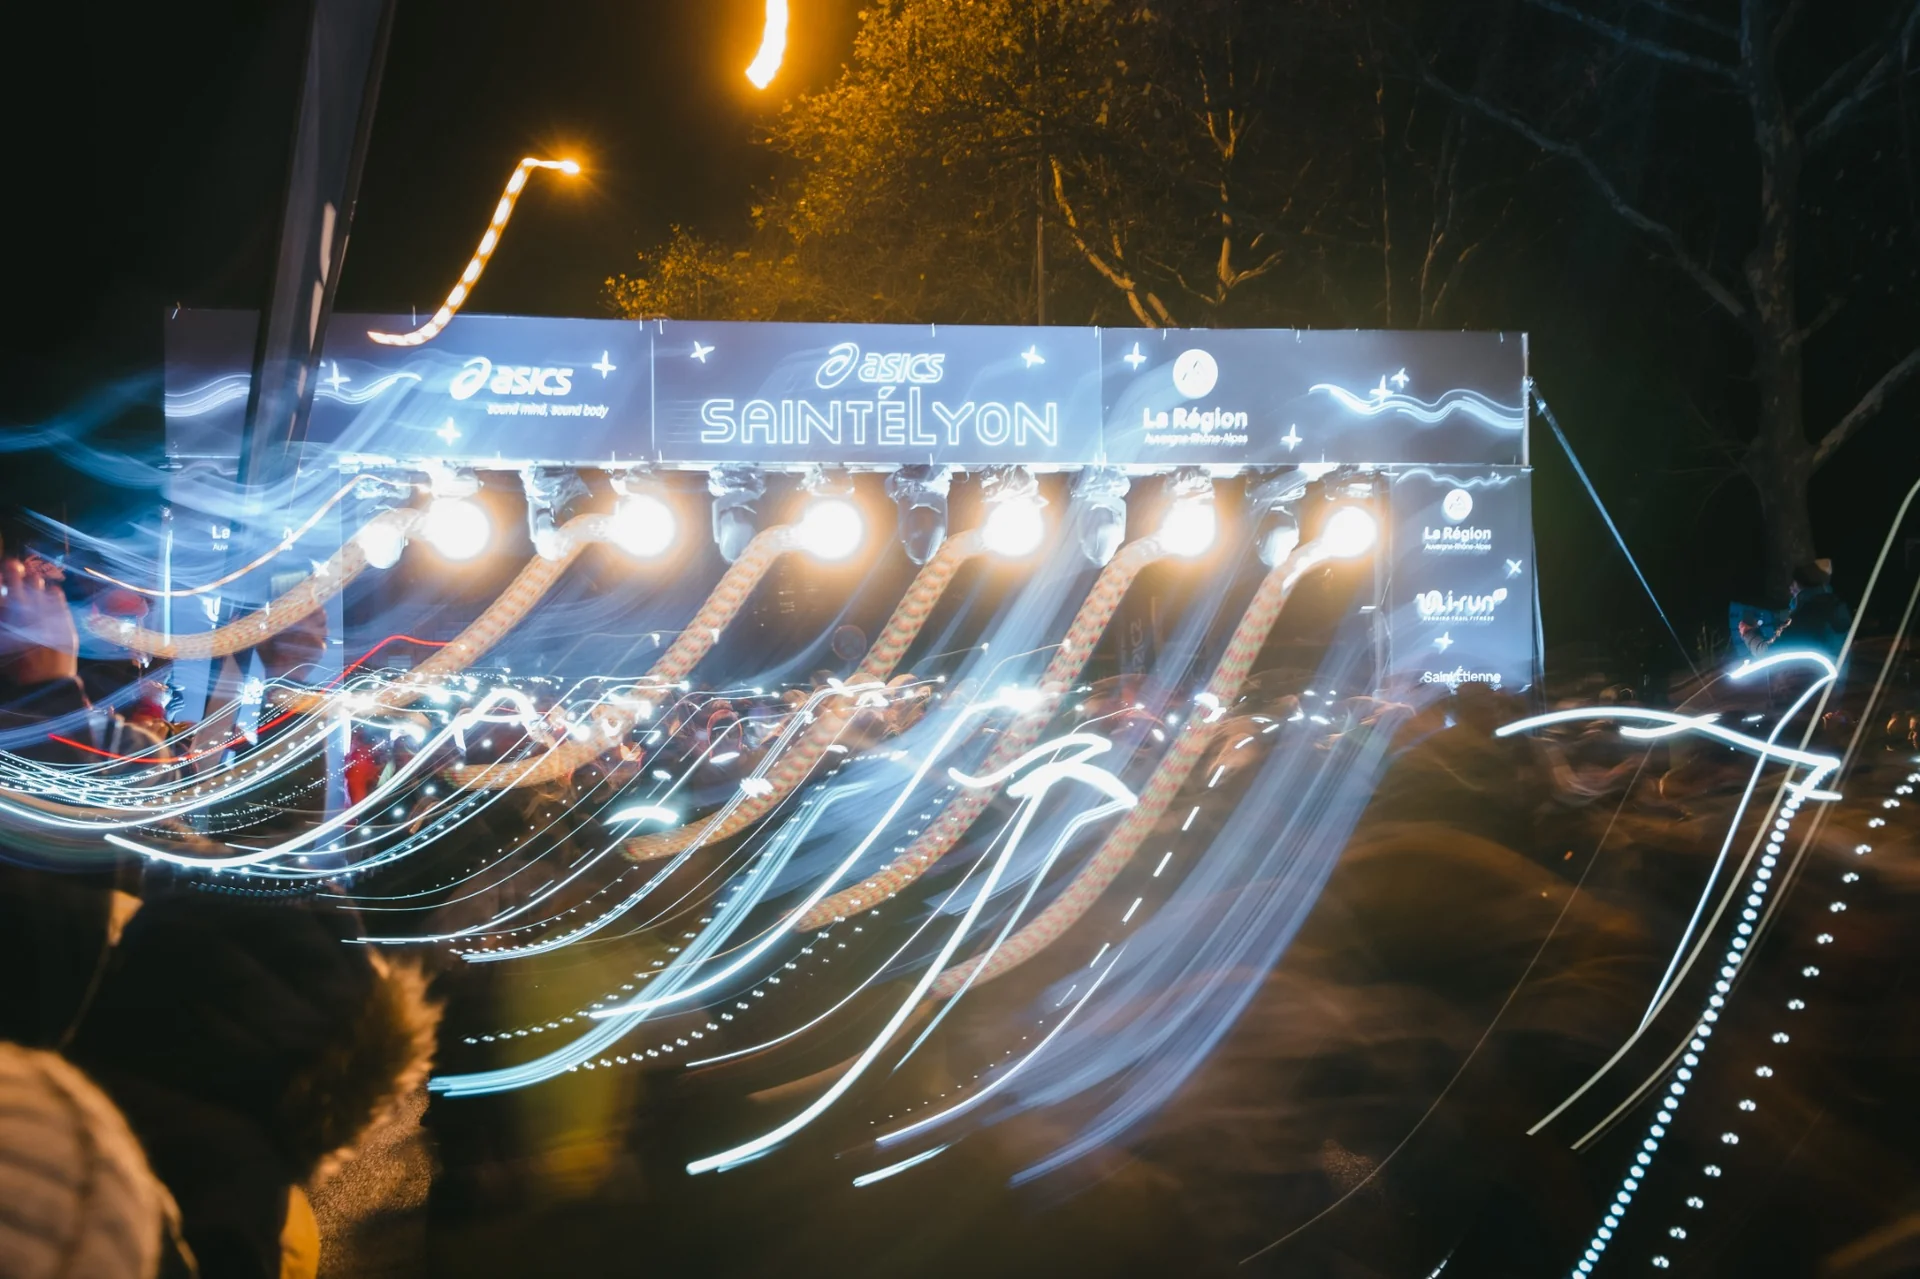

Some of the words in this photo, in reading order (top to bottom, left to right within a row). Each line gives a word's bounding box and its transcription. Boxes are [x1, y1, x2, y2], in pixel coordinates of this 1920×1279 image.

[490, 366, 573, 396] asics
[859, 353, 945, 383] asics
[486, 401, 519, 416] sound
[550, 403, 582, 417] sound
[583, 403, 609, 419] body
[701, 386, 1058, 446] SAINTÉLYON
[1143, 407, 1169, 429] La
[1173, 406, 1248, 434] Région
[1424, 526, 1441, 540] La
[1443, 525, 1492, 543] Région
